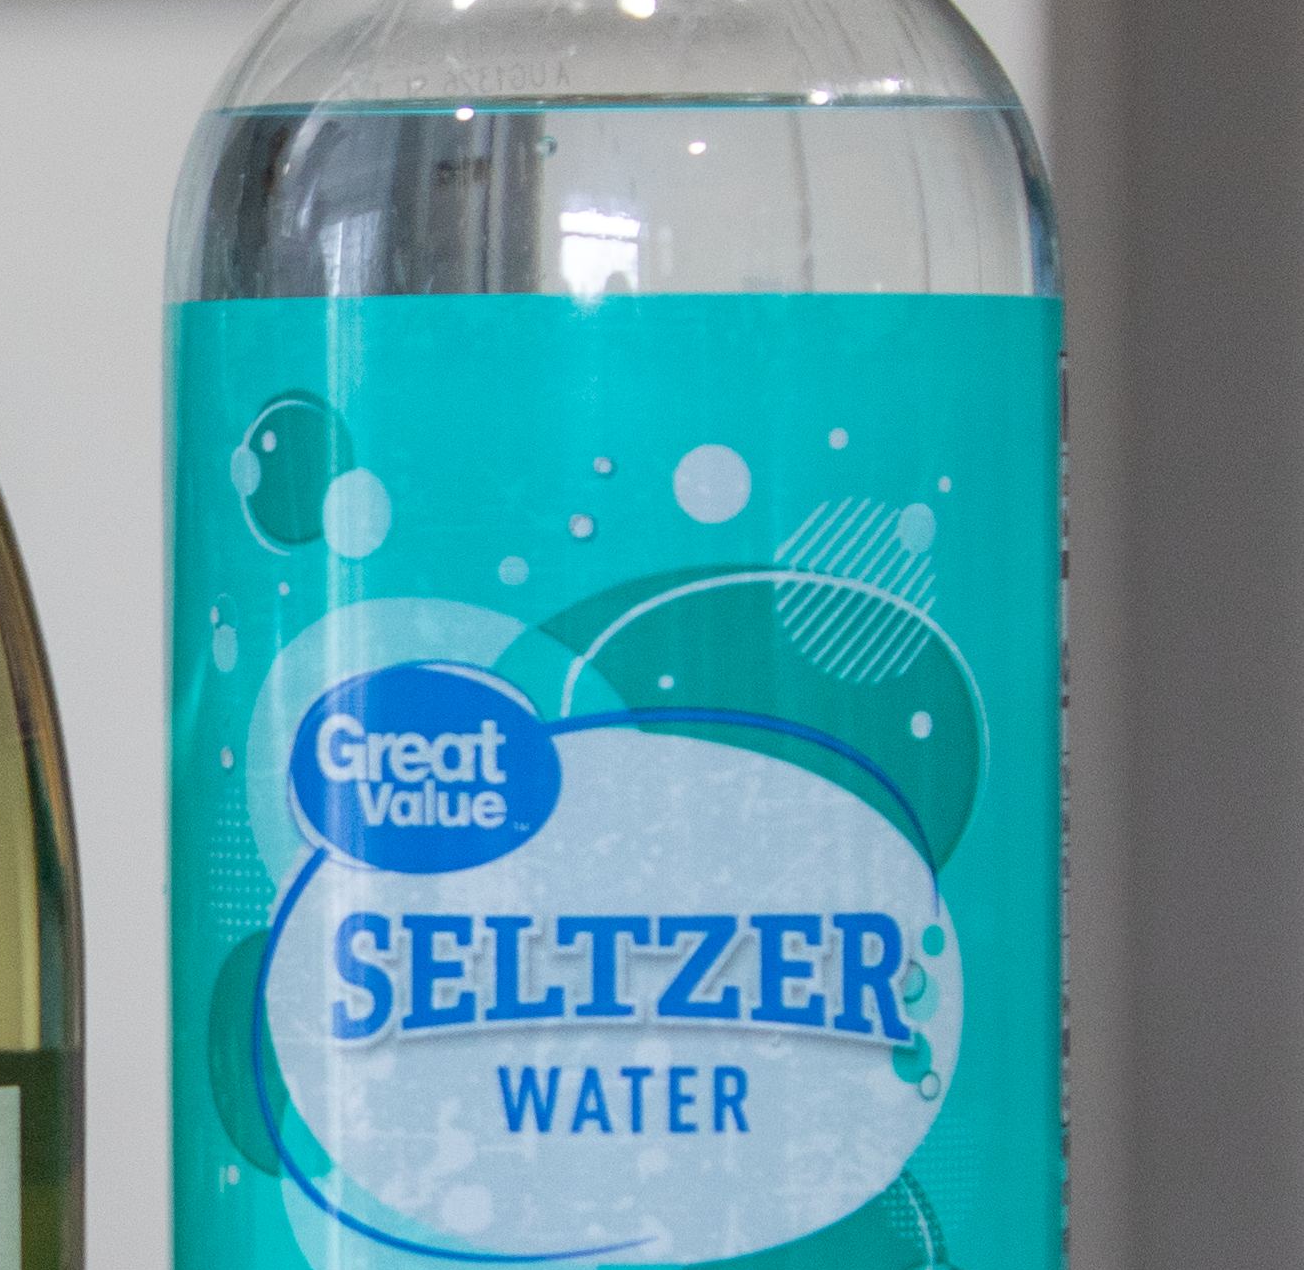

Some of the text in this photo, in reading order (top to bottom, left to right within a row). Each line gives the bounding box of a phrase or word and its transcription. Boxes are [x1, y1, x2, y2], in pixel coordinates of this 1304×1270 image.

[315, 713, 507, 785] Great
[357, 777, 508, 829] Value
[329, 911, 913, 1045] SELTZER
[496, 1064, 750, 1135] WATER
